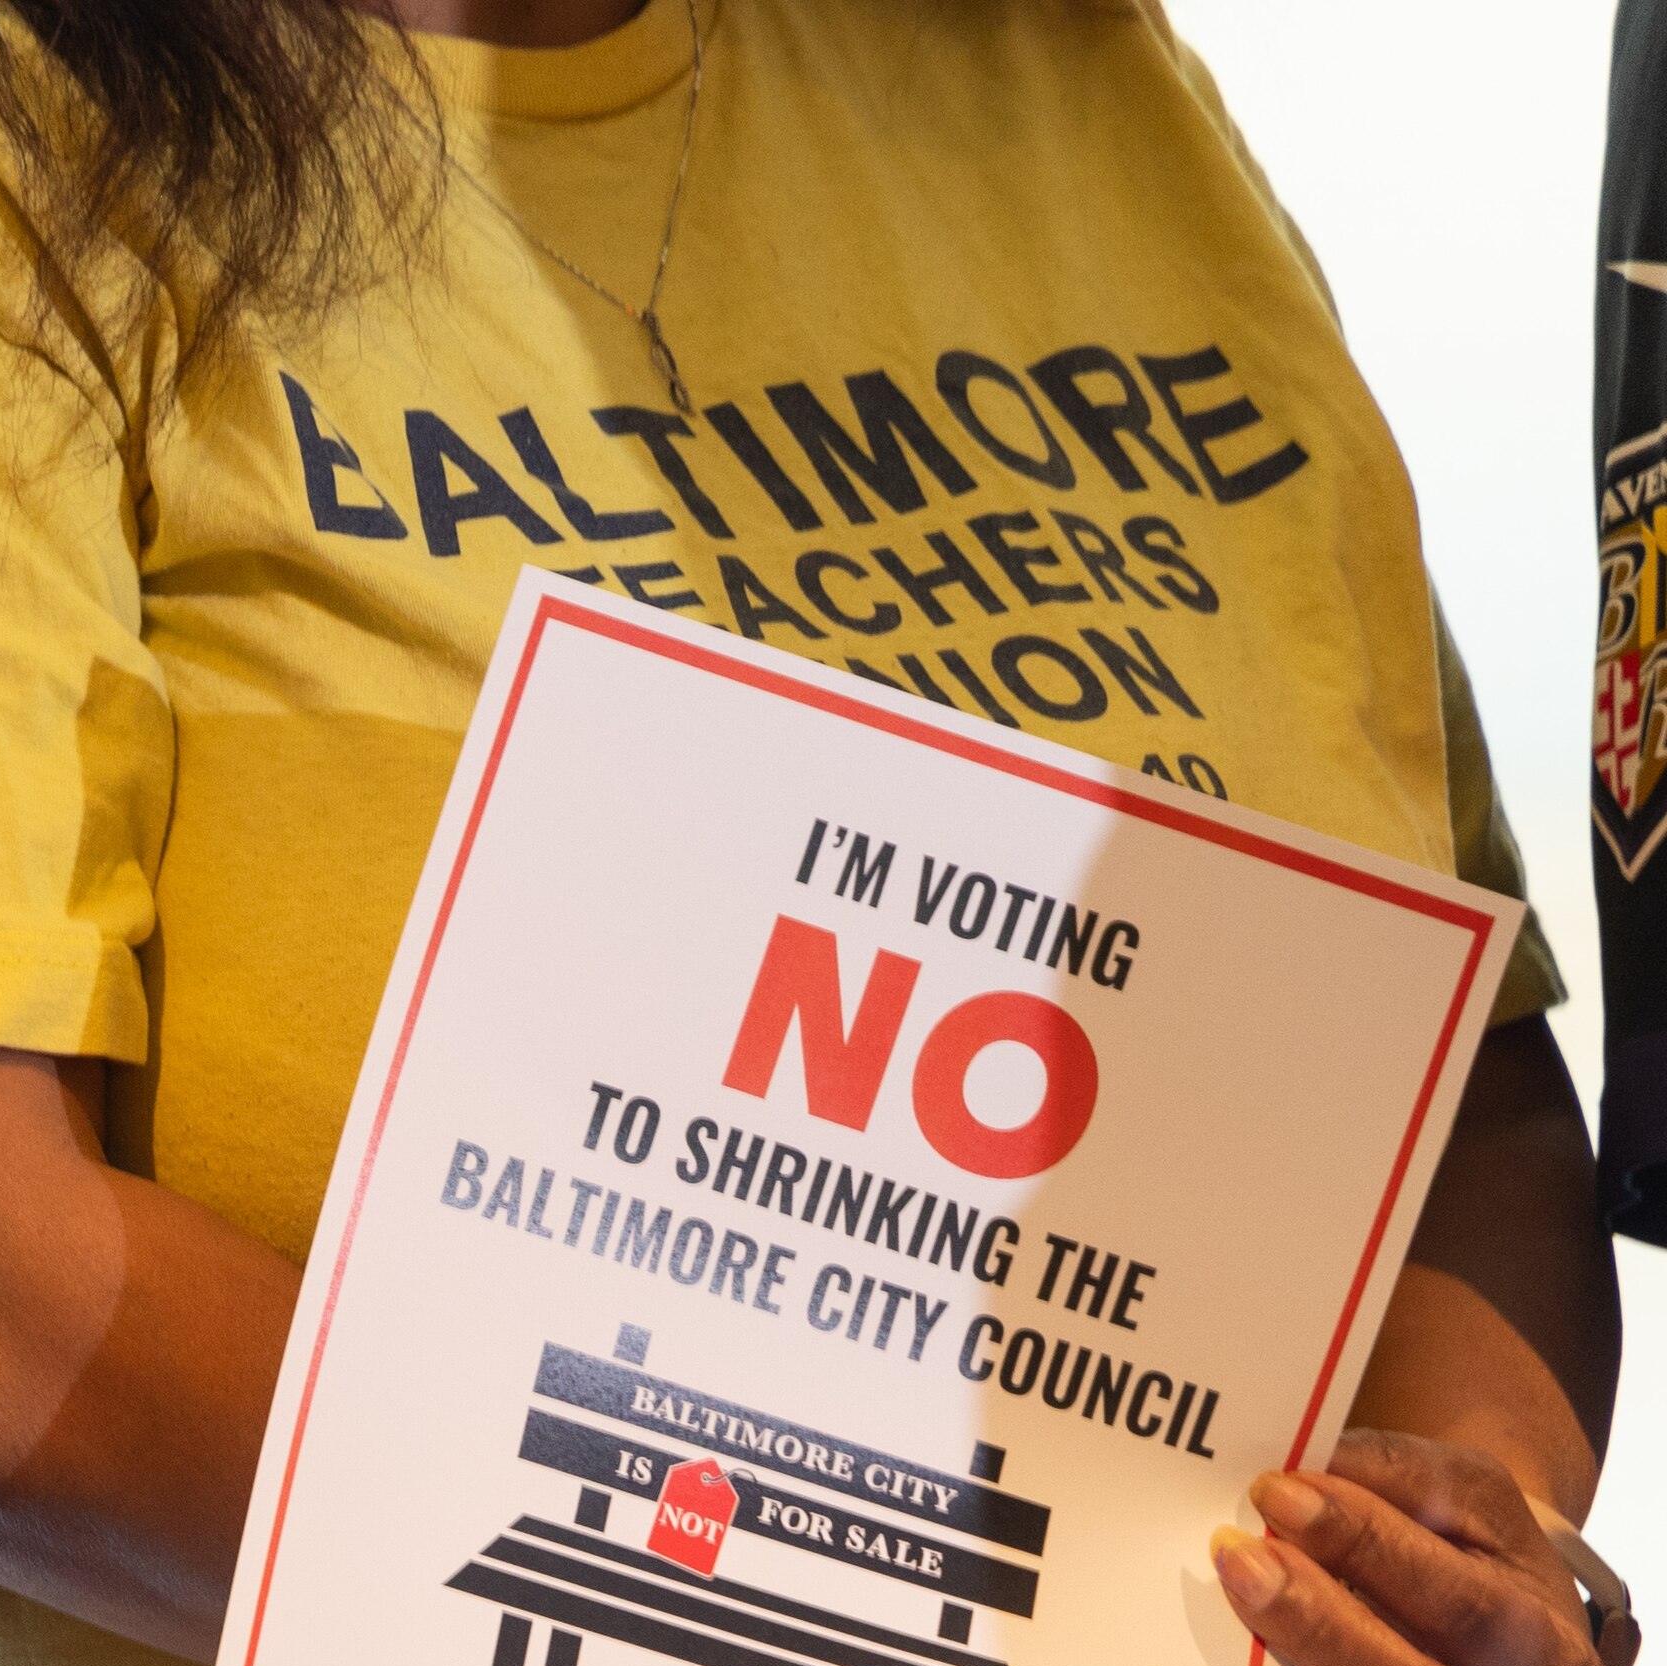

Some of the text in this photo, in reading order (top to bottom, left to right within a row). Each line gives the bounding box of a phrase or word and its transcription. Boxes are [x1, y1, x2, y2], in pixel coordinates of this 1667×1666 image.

[277, 343, 1310, 558] BALTIMORE
[549, 505, 1222, 641] EACHERS
[795, 817, 1141, 992] I'M VOTING
[721, 912, 1100, 1181] NO
[582, 1081, 1157, 1331] TO SHRINKING THE
[440, 1138, 1222, 1460] BALTIMORE CITY COUNCIL
[615, 1450, 944, 1578] IS FOR SALE
[630, 1385, 959, 1514] BALTIMORE CITY
[659, 1502, 724, 1545] NOT
